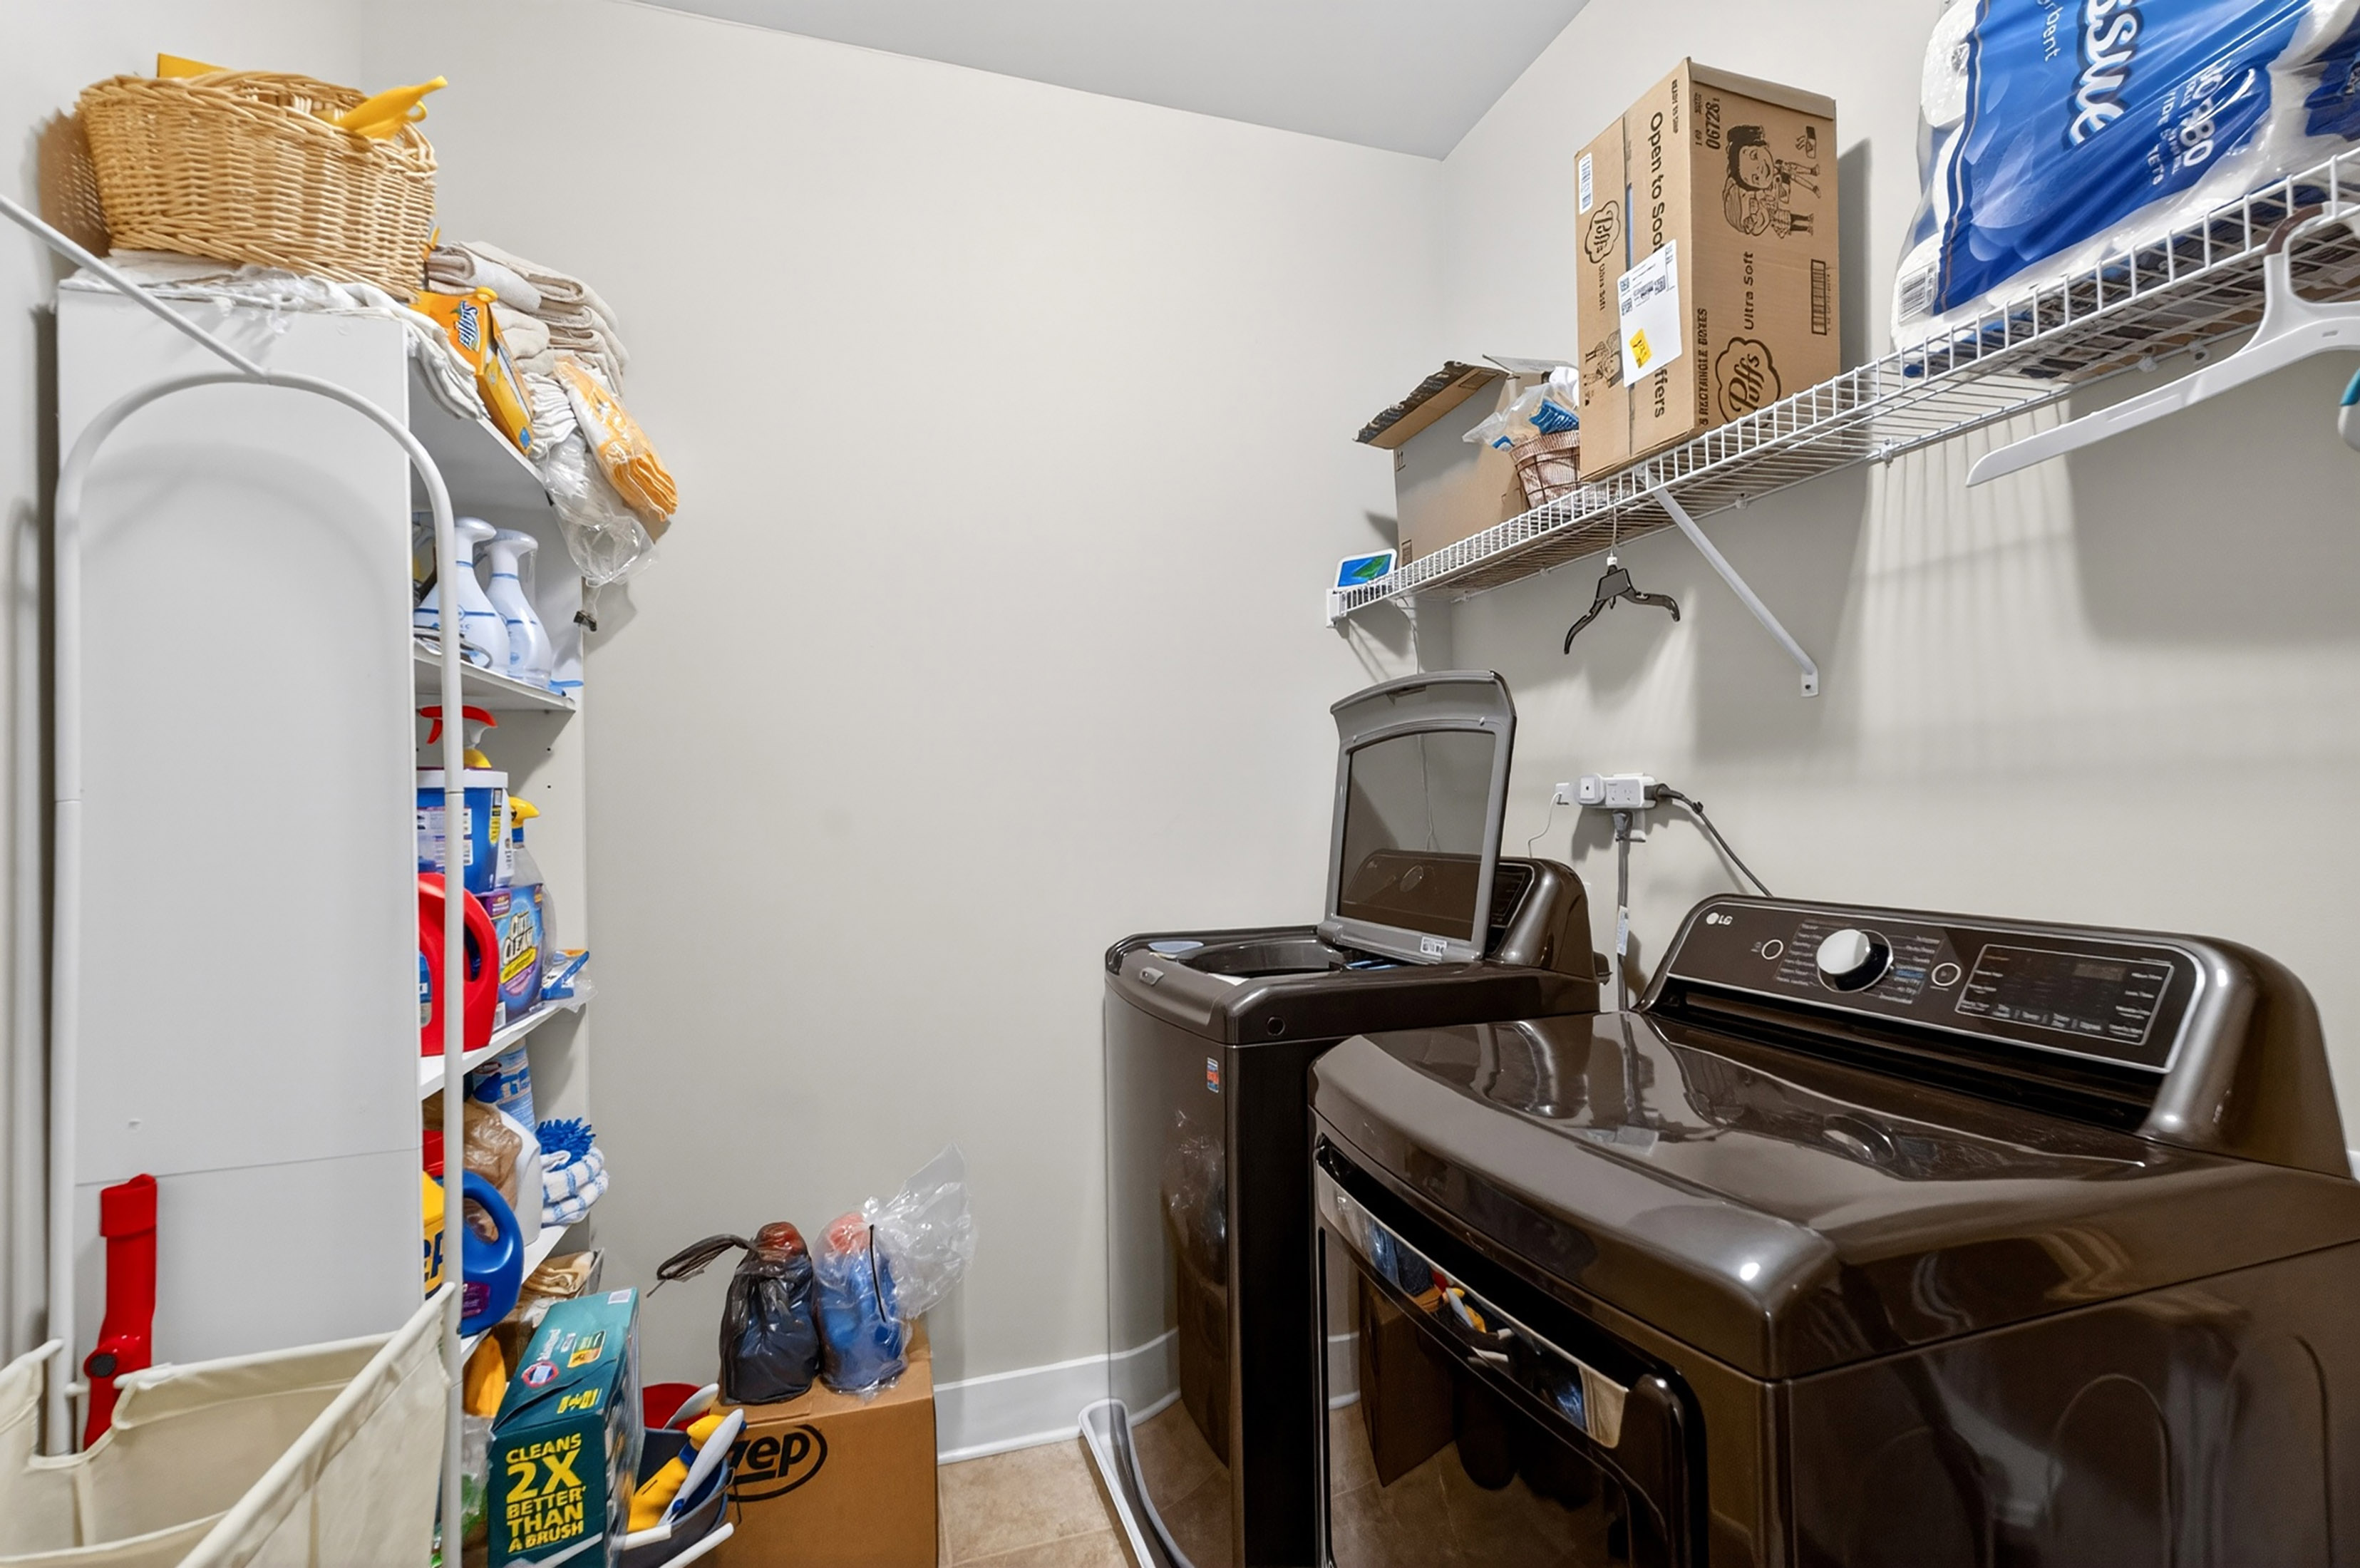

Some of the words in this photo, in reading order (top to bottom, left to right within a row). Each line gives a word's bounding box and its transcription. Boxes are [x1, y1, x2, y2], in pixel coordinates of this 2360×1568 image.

[1648, 112, 1664, 172] Open
[1652, 174, 1664, 199] to
[1742, 251, 1754, 286] Soft
[1743, 290, 1754, 330] Ultra
[1728, 354, 1764, 413] Puffs
[505, 1433, 582, 1463] CLEANS
[506, 1448, 582, 1504] 2X
[507, 1502, 584, 1537] THAN
[507, 1537, 522, 1553] A
[525, 1520, 584, 1548] BRUSH
